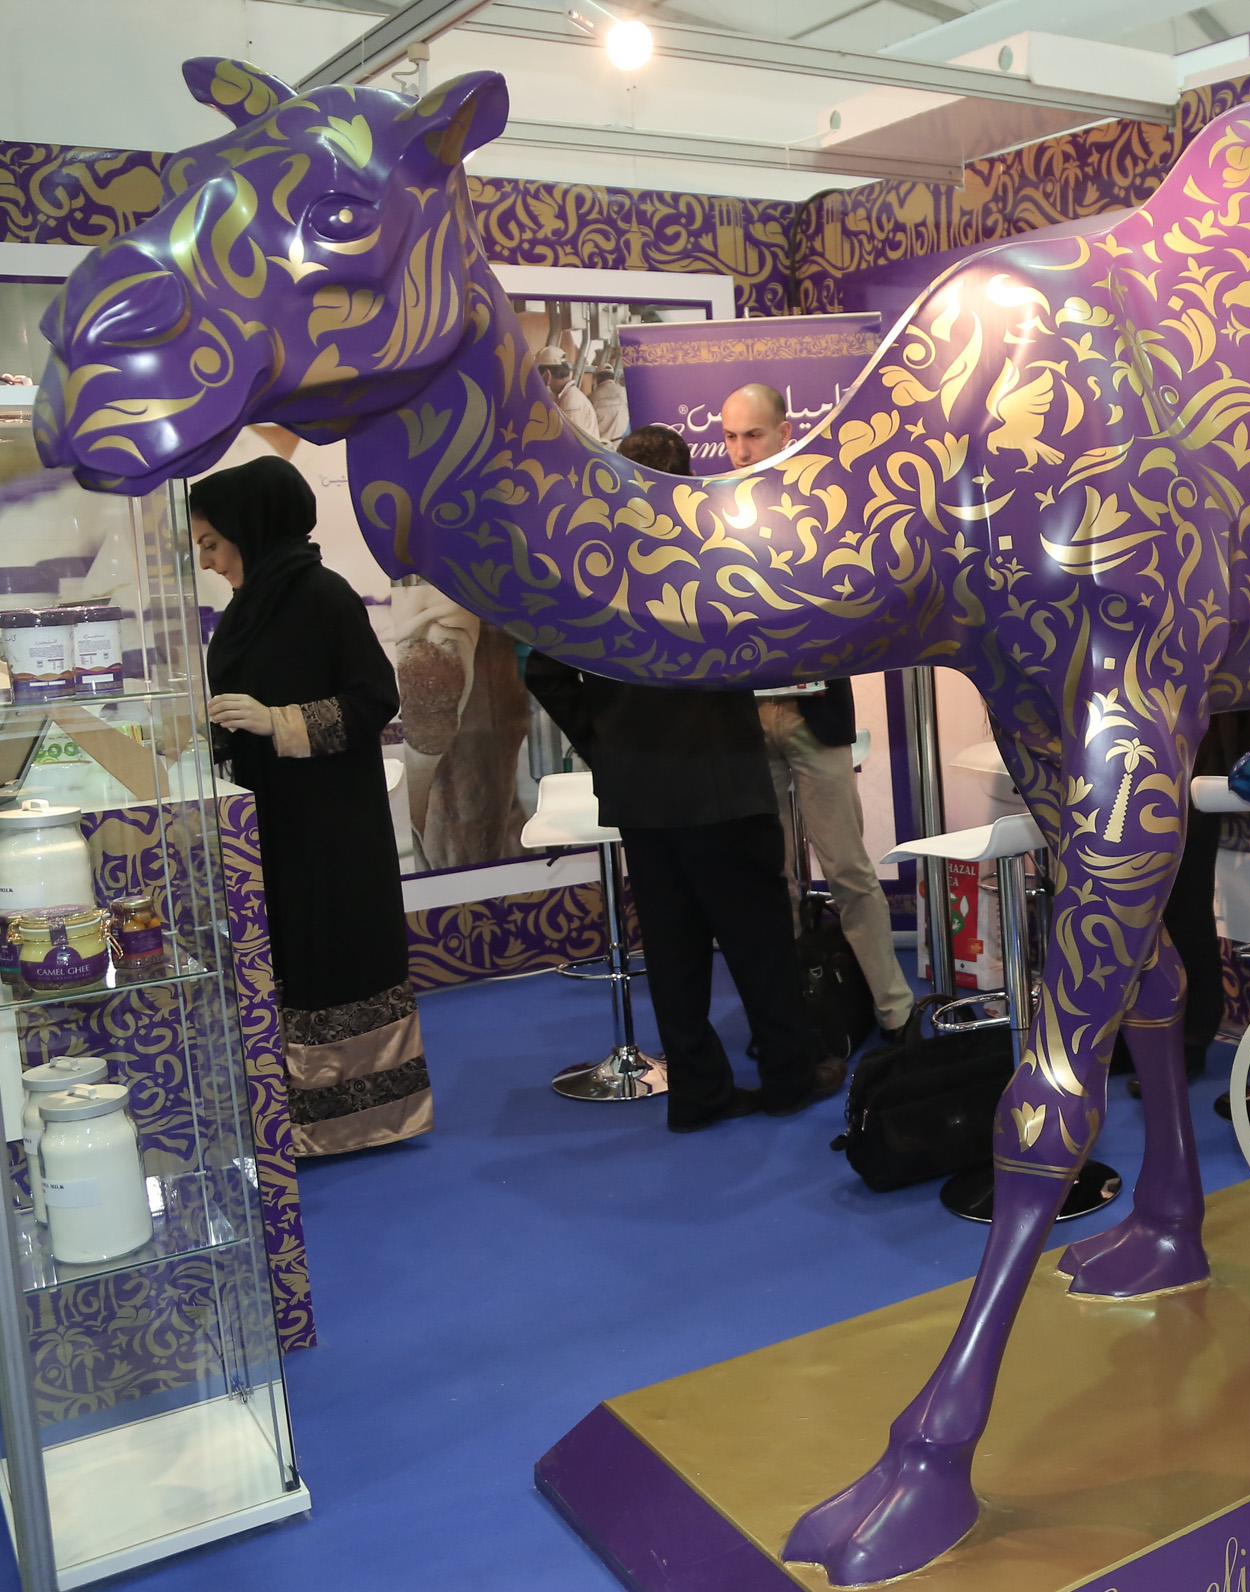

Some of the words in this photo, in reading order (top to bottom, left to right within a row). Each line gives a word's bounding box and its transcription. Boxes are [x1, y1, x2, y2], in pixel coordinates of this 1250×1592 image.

[948, 863, 976, 875] HAZAL
[36, 967, 66, 977] CAMEL
[67, 964, 90, 975] GHEE
